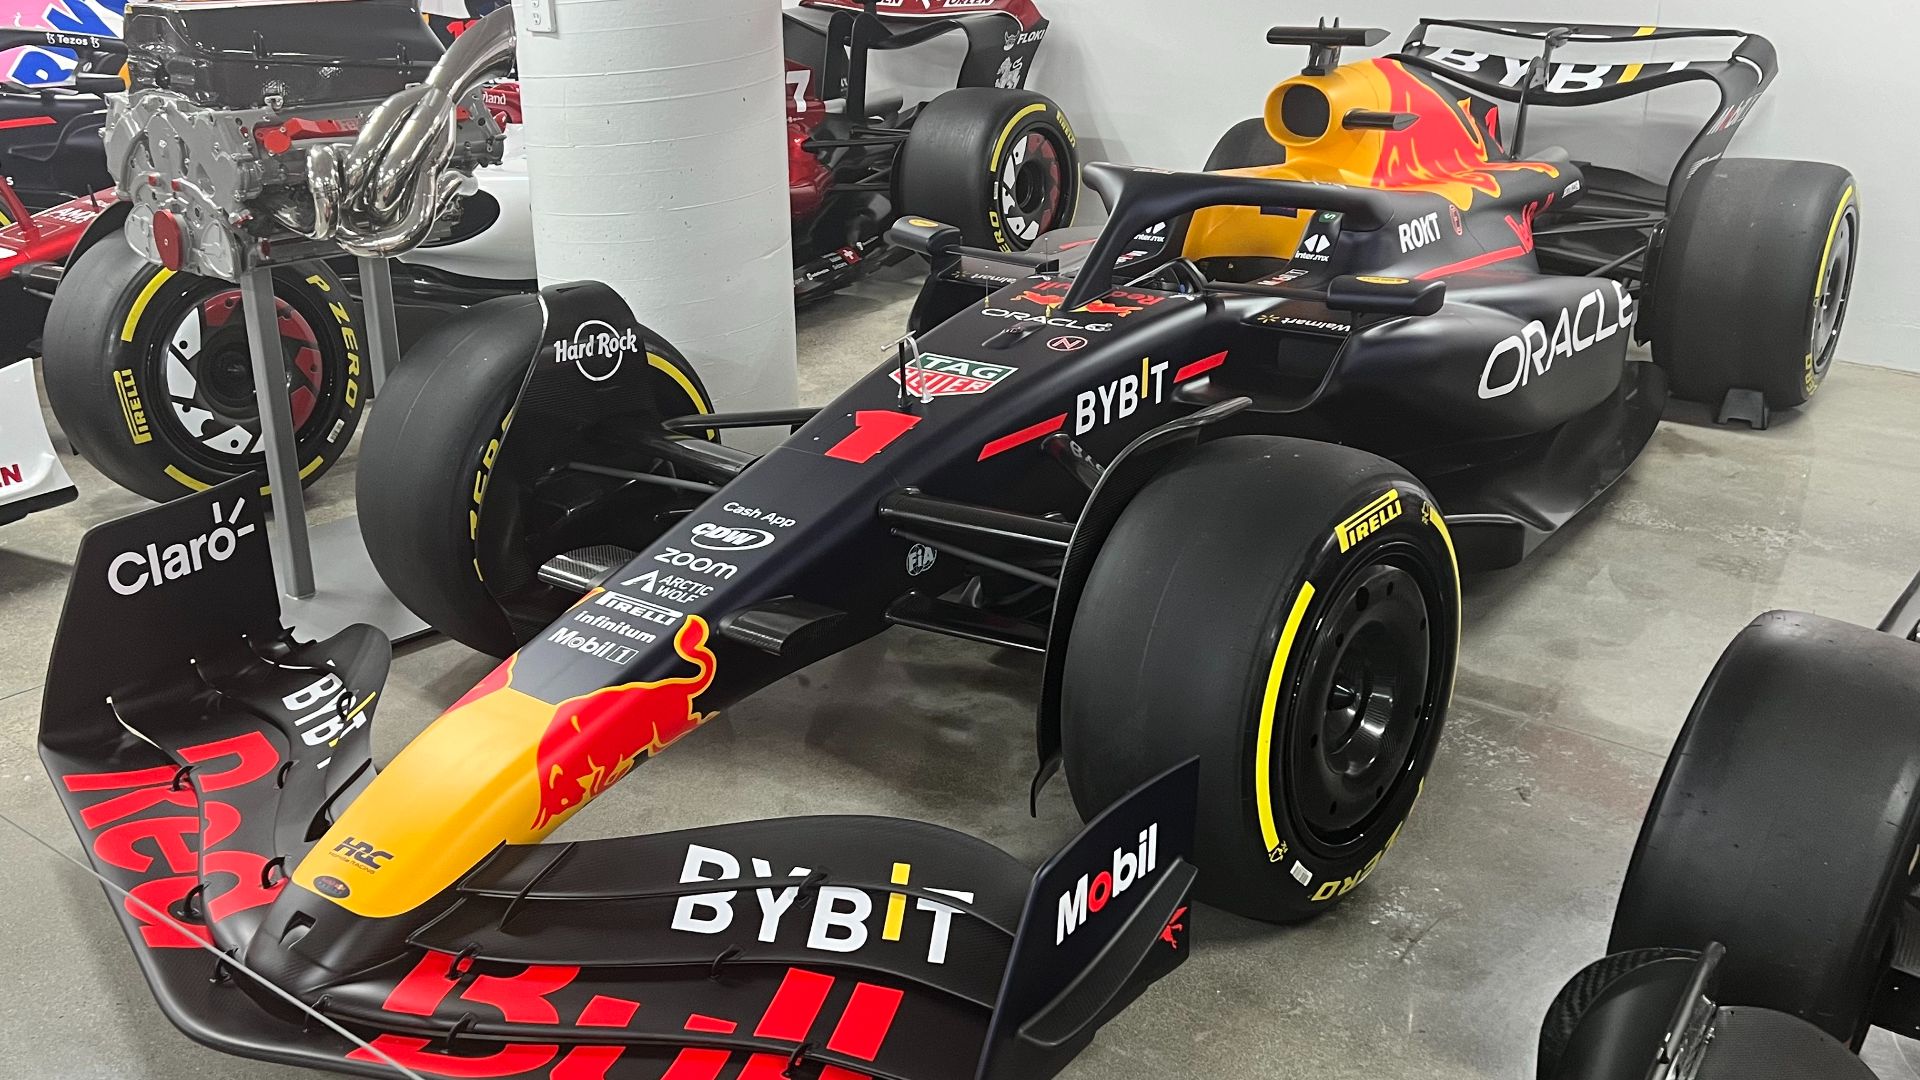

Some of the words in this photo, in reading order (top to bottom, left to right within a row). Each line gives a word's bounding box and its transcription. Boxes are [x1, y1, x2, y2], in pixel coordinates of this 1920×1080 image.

[56, 34, 88, 46] Tezos
[1017, 29, 1045, 45] FLOKI
[786, 70, 811, 112] 7
[1398, 211, 1441, 254] ROKT
[1294, 250, 1329, 262] inter.mx
[981, 308, 1113, 332] ORACLE
[1280, 317, 1351, 332] Walmart
[305, 274, 331, 292] P
[328, 301, 360, 409] ZERO
[553, 334, 595, 363] Hard
[596, 327, 638, 358] Rock
[1478, 279, 1634, 400] ORACLE
[923, 356, 1004, 380] TAG
[113, 369, 152, 445] PIRELLI
[1075, 356, 1169, 437] BYBIT
[824, 410, 923, 465] 1
[722, 501, 762, 519] Cash
[760, 512, 797, 527] App
[1334, 488, 1402, 554] PIRELLI
[691, 523, 758, 546] CDW
[107, 526, 237, 596] Claro
[654, 547, 738, 580] zoom
[655, 585, 700, 604] WOLF
[658, 575, 714, 597] ARCTIC
[595, 590, 684, 626] PIRELLI
[547, 626, 617, 658] Mobil
[573, 610, 657, 644] infinitum
[62, 731, 290, 948] Red
[333, 836, 394, 870] HRC
[1056, 822, 1158, 946] Mobil
[671, 843, 975, 964] BYBIT
[343, 948, 904, 1080] Bull
